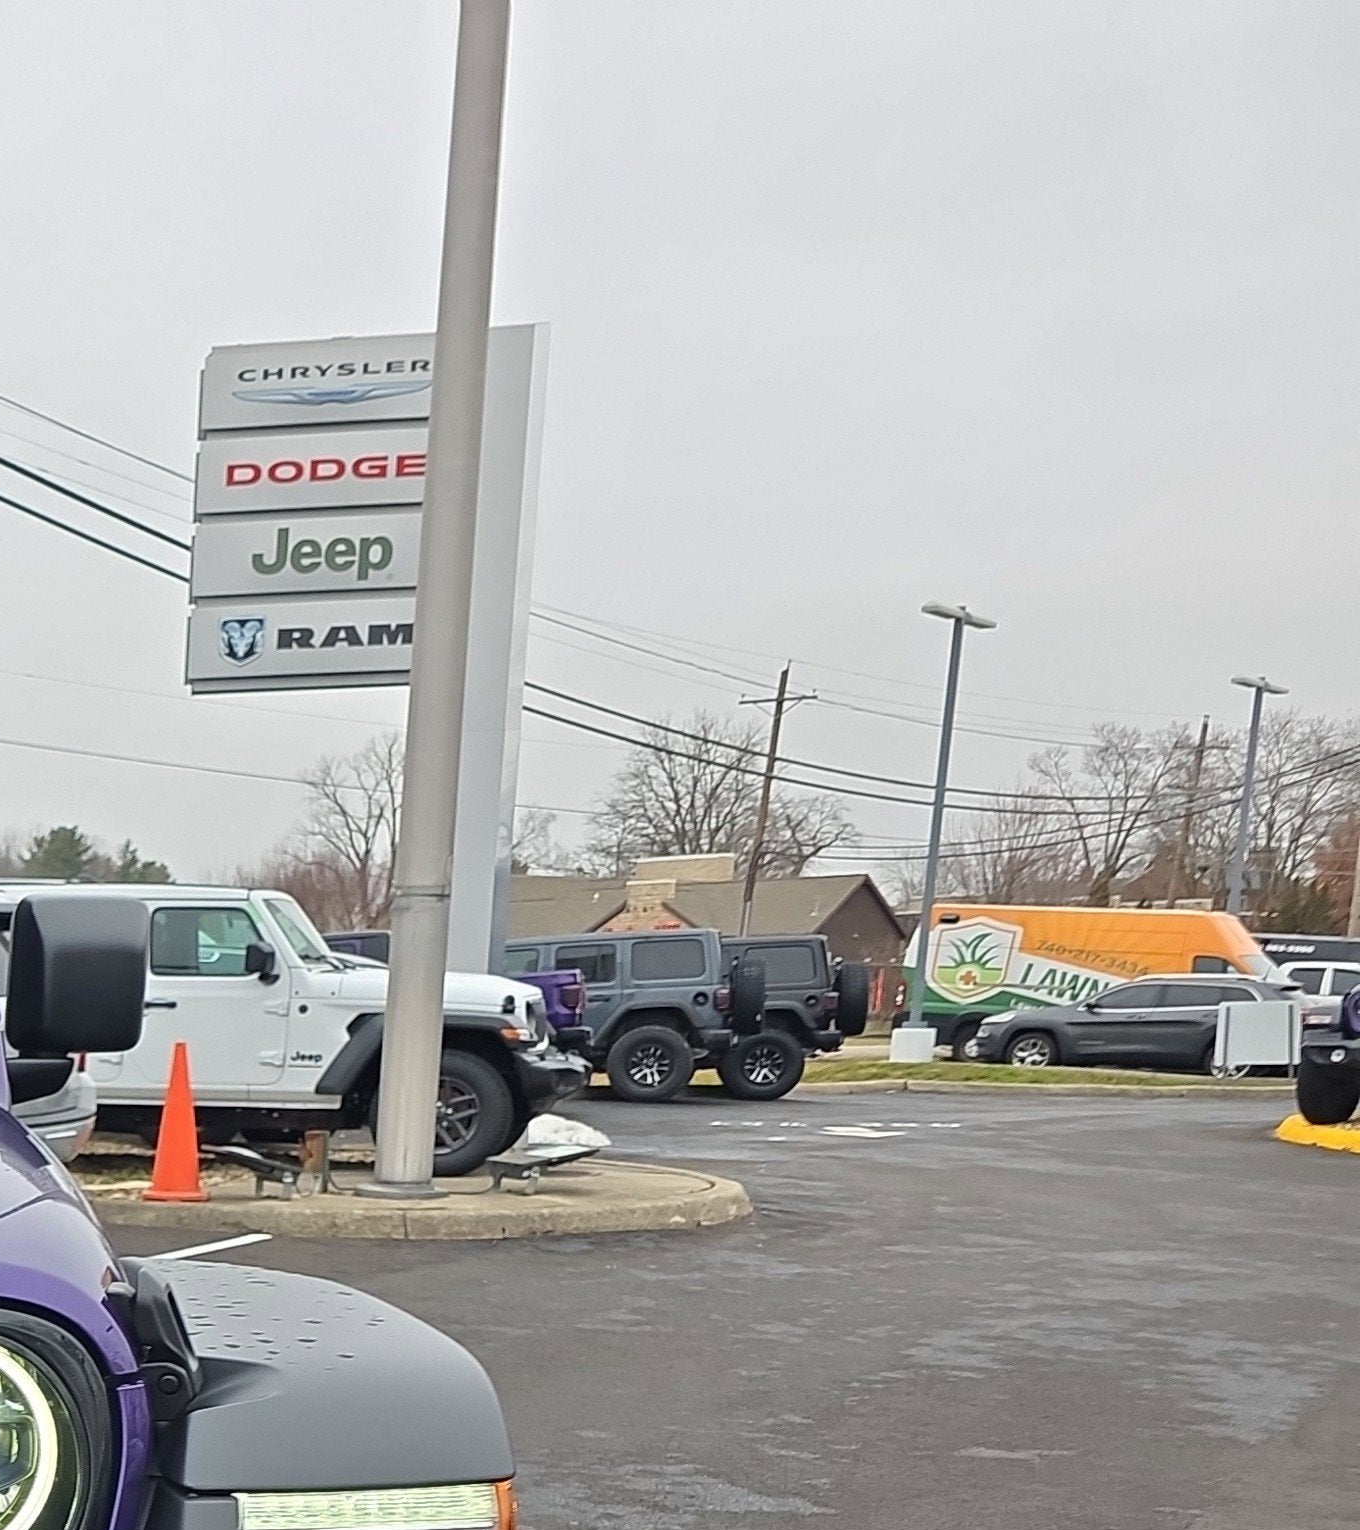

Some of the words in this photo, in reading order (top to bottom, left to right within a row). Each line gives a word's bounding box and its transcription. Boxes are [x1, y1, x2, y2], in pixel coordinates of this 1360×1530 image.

[236, 358, 431, 382] CHRYSLER
[224, 453, 427, 487] DODGE
[251, 526, 394, 581] Jeep
[276, 622, 414, 650] RAM
[290, 1050, 323, 1063] Jeep
